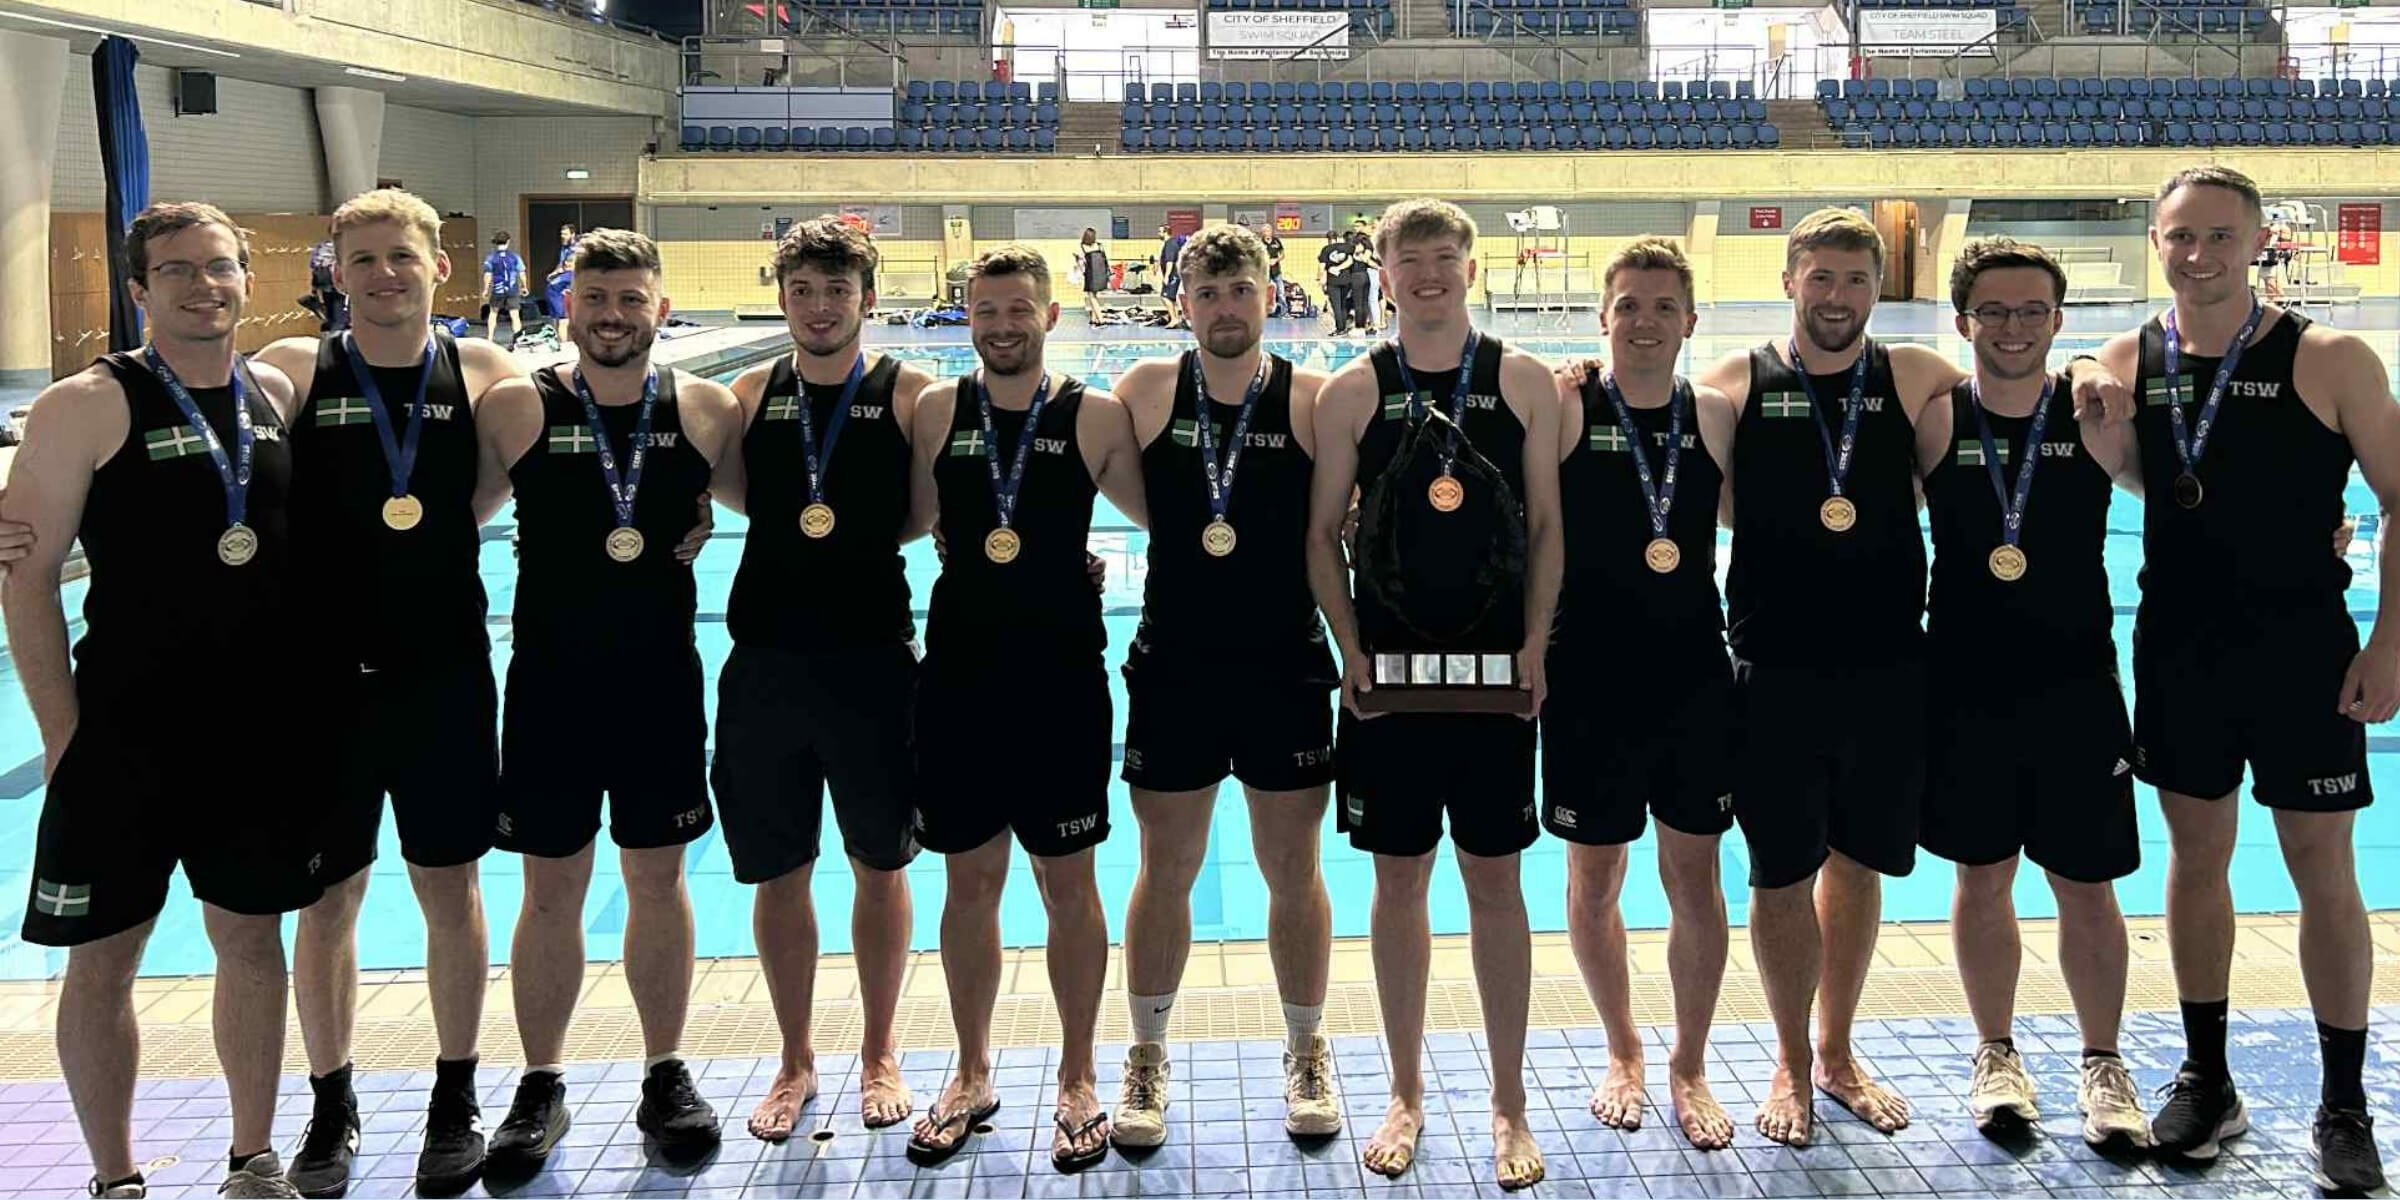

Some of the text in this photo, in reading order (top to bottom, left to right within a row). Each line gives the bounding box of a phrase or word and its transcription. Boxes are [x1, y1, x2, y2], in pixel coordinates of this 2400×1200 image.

[1224, 15, 1337, 24] CITY OF SHEFFIELD
[1239, 30, 1275, 40] SWIM
[1893, 29, 1966, 40] TEAM STEEL
[2228, 380, 2281, 398] TSW
[1465, 393, 1498, 411] SW
[1837, 397, 1884, 412] TW
[849, 404, 883, 420] SW
[253, 424, 281, 442] SW
[1652, 431, 1697, 449] TW
[1033, 437, 1067, 456] SW
[2040, 442, 2076, 458] SW
[2307, 772, 2357, 796] TSW
[1056, 812, 1098, 838] TSW
